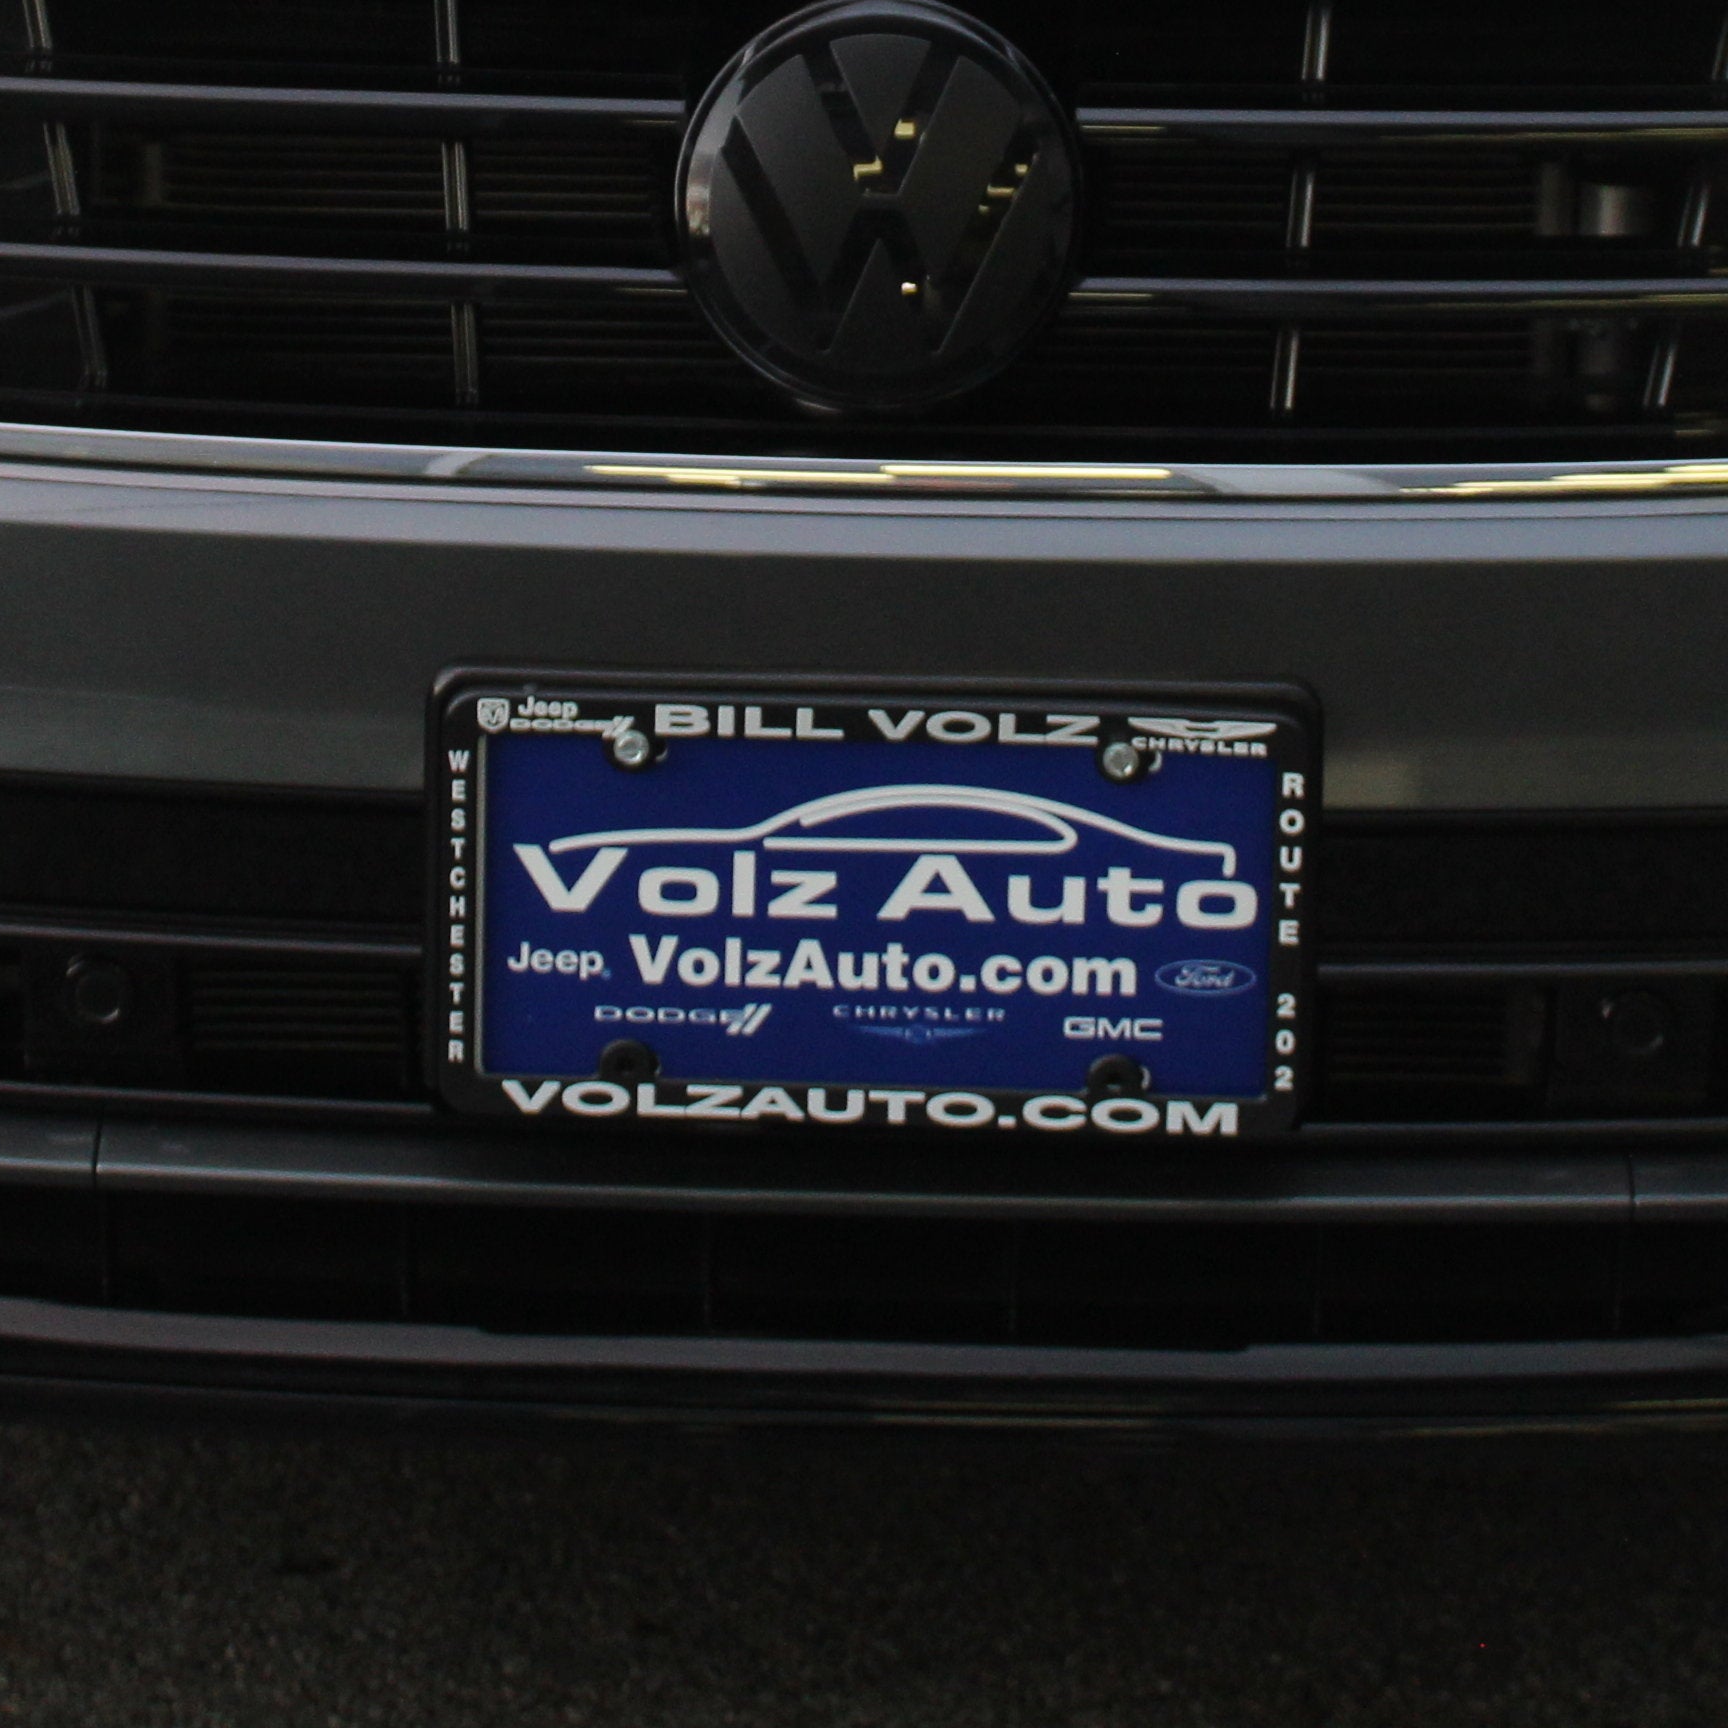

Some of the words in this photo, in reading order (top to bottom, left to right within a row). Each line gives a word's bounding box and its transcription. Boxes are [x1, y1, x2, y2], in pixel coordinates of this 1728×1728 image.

[518, 695, 579, 720] Jeep
[655, 703, 845, 739] BILL
[867, 709, 1101, 745] VOLZ
[1131, 736, 1268, 758] CHRYSLER
[1278, 771, 1305, 947] ROUTE
[447, 749, 470, 1063] WESTCHESTER
[512, 842, 839, 920] Volz
[875, 853, 1259, 930] Auto
[506, 940, 606, 981] Jeep
[628, 934, 1138, 996] VolzAuto.com
[594, 1004, 757, 1027] DODGE
[832, 1004, 1007, 1023] CHRYSLER
[1063, 1016, 1164, 1041] GMC
[1274, 992, 1297, 1091] 202
[501, 1079, 1239, 1136] VOLZAUTO.COM
